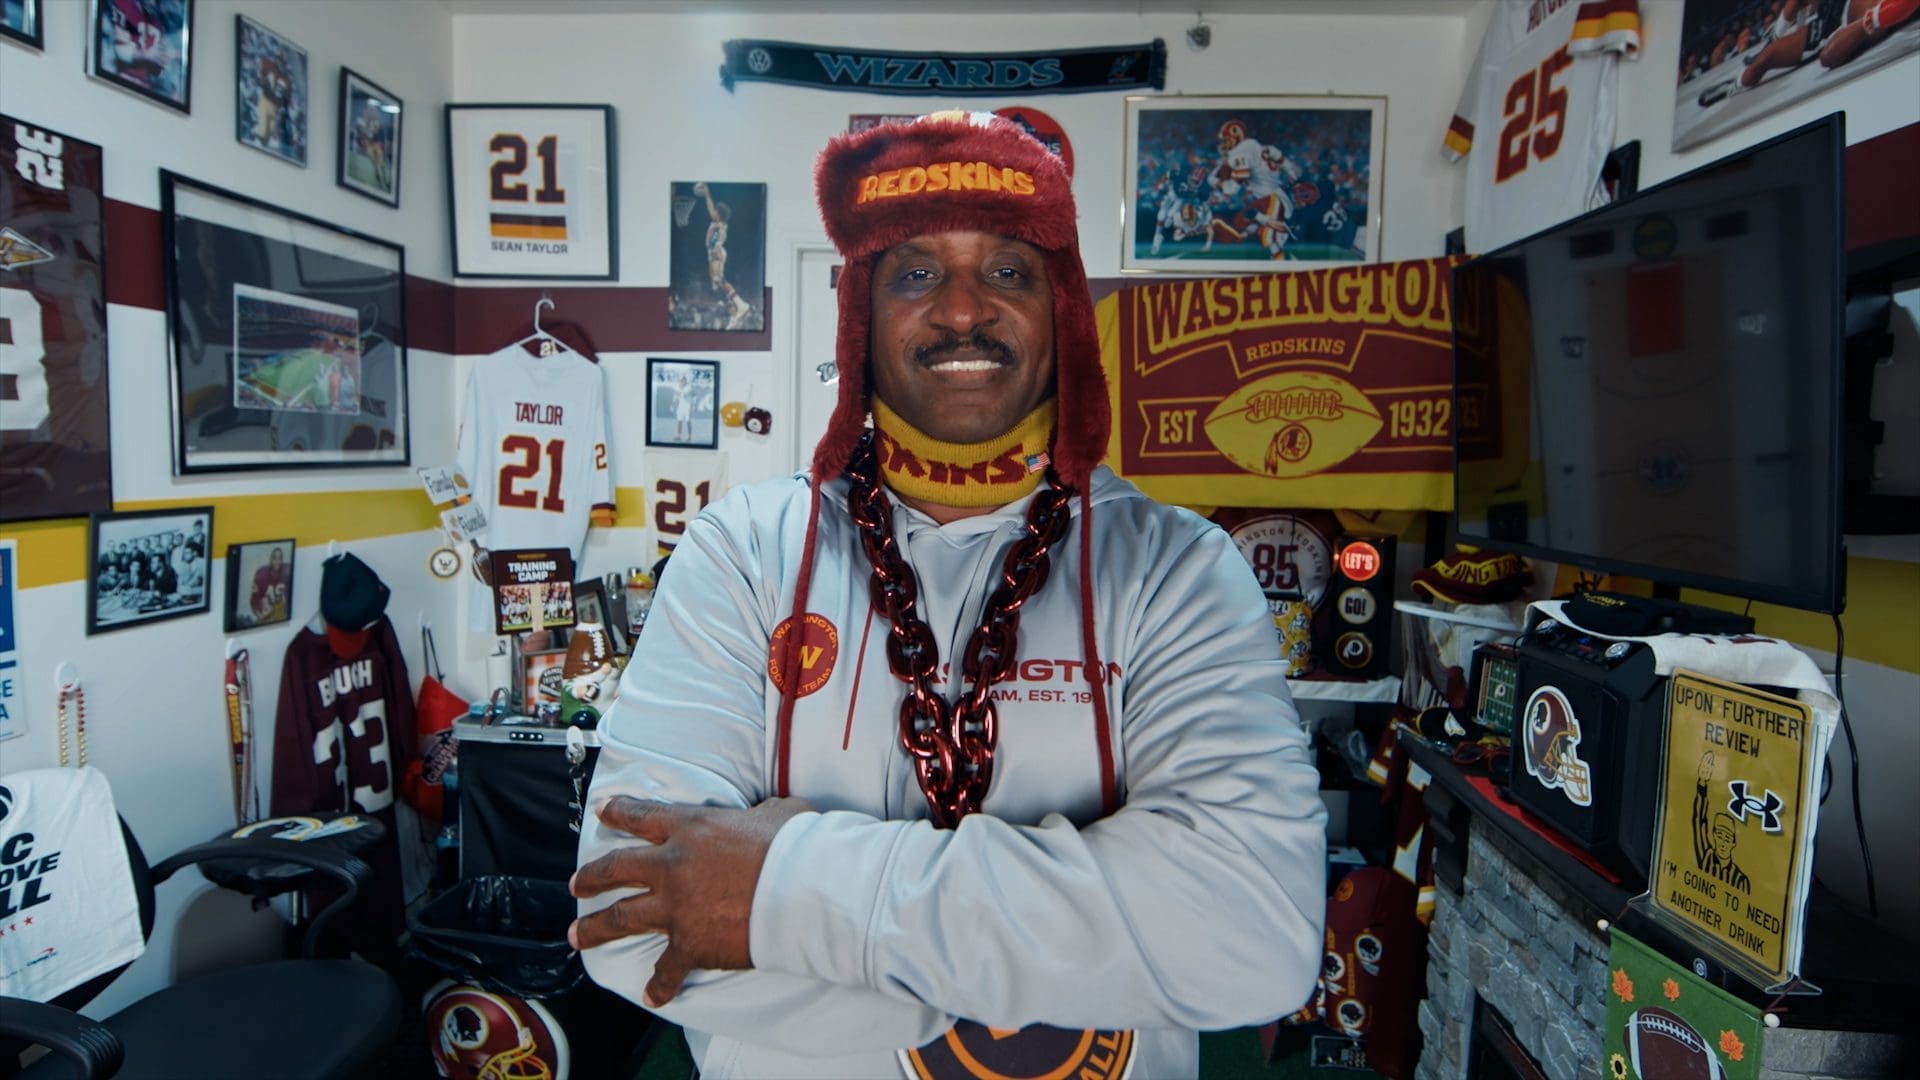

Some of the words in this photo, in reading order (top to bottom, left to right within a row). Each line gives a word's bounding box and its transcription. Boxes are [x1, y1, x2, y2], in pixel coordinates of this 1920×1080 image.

[813, 52, 1065, 88] WIZARDS
[1495, 43, 1575, 185] 25
[488, 133, 566, 204] 21
[857, 162, 1036, 204] REDSKINS
[491, 241, 522, 252] SEAN
[526, 243, 568, 254] TAYLOR
[1246, 337, 1346, 362] REDSKINS
[515, 402, 563, 425] TAYLOR
[1159, 410, 1197, 445] EST
[1388, 401, 1449, 438] 1932
[498, 434, 565, 513] 21
[656, 478, 711, 535] 21
[507, 560, 556, 573] TRAINING
[517, 571, 549, 582] CAMP
[1252, 544, 1299, 590] 85
[1345, 553, 1373, 571] LET'S
[1344, 597, 1367, 616] GO!
[774, 615, 837, 649] WAINGTON
[803, 668, 831, 692] TEAM
[988, 690, 1022, 703] AM,
[1029, 690, 1066, 702] EST.
[1072, 691, 1093, 703] 19
[1675, 686, 1713, 714] UPON
[1723, 700, 1800, 741] FURTHER
[1705, 722, 1760, 758] REVIEW
[1664, 859, 1677, 879] I'M
[1684, 871, 1717, 899] GOING
[1725, 892, 1740, 912] TO
[1746, 904, 1780, 935] NEED
[1670, 891, 1722, 930] ANOTHER
[1729, 922, 1765, 957] DRINK
